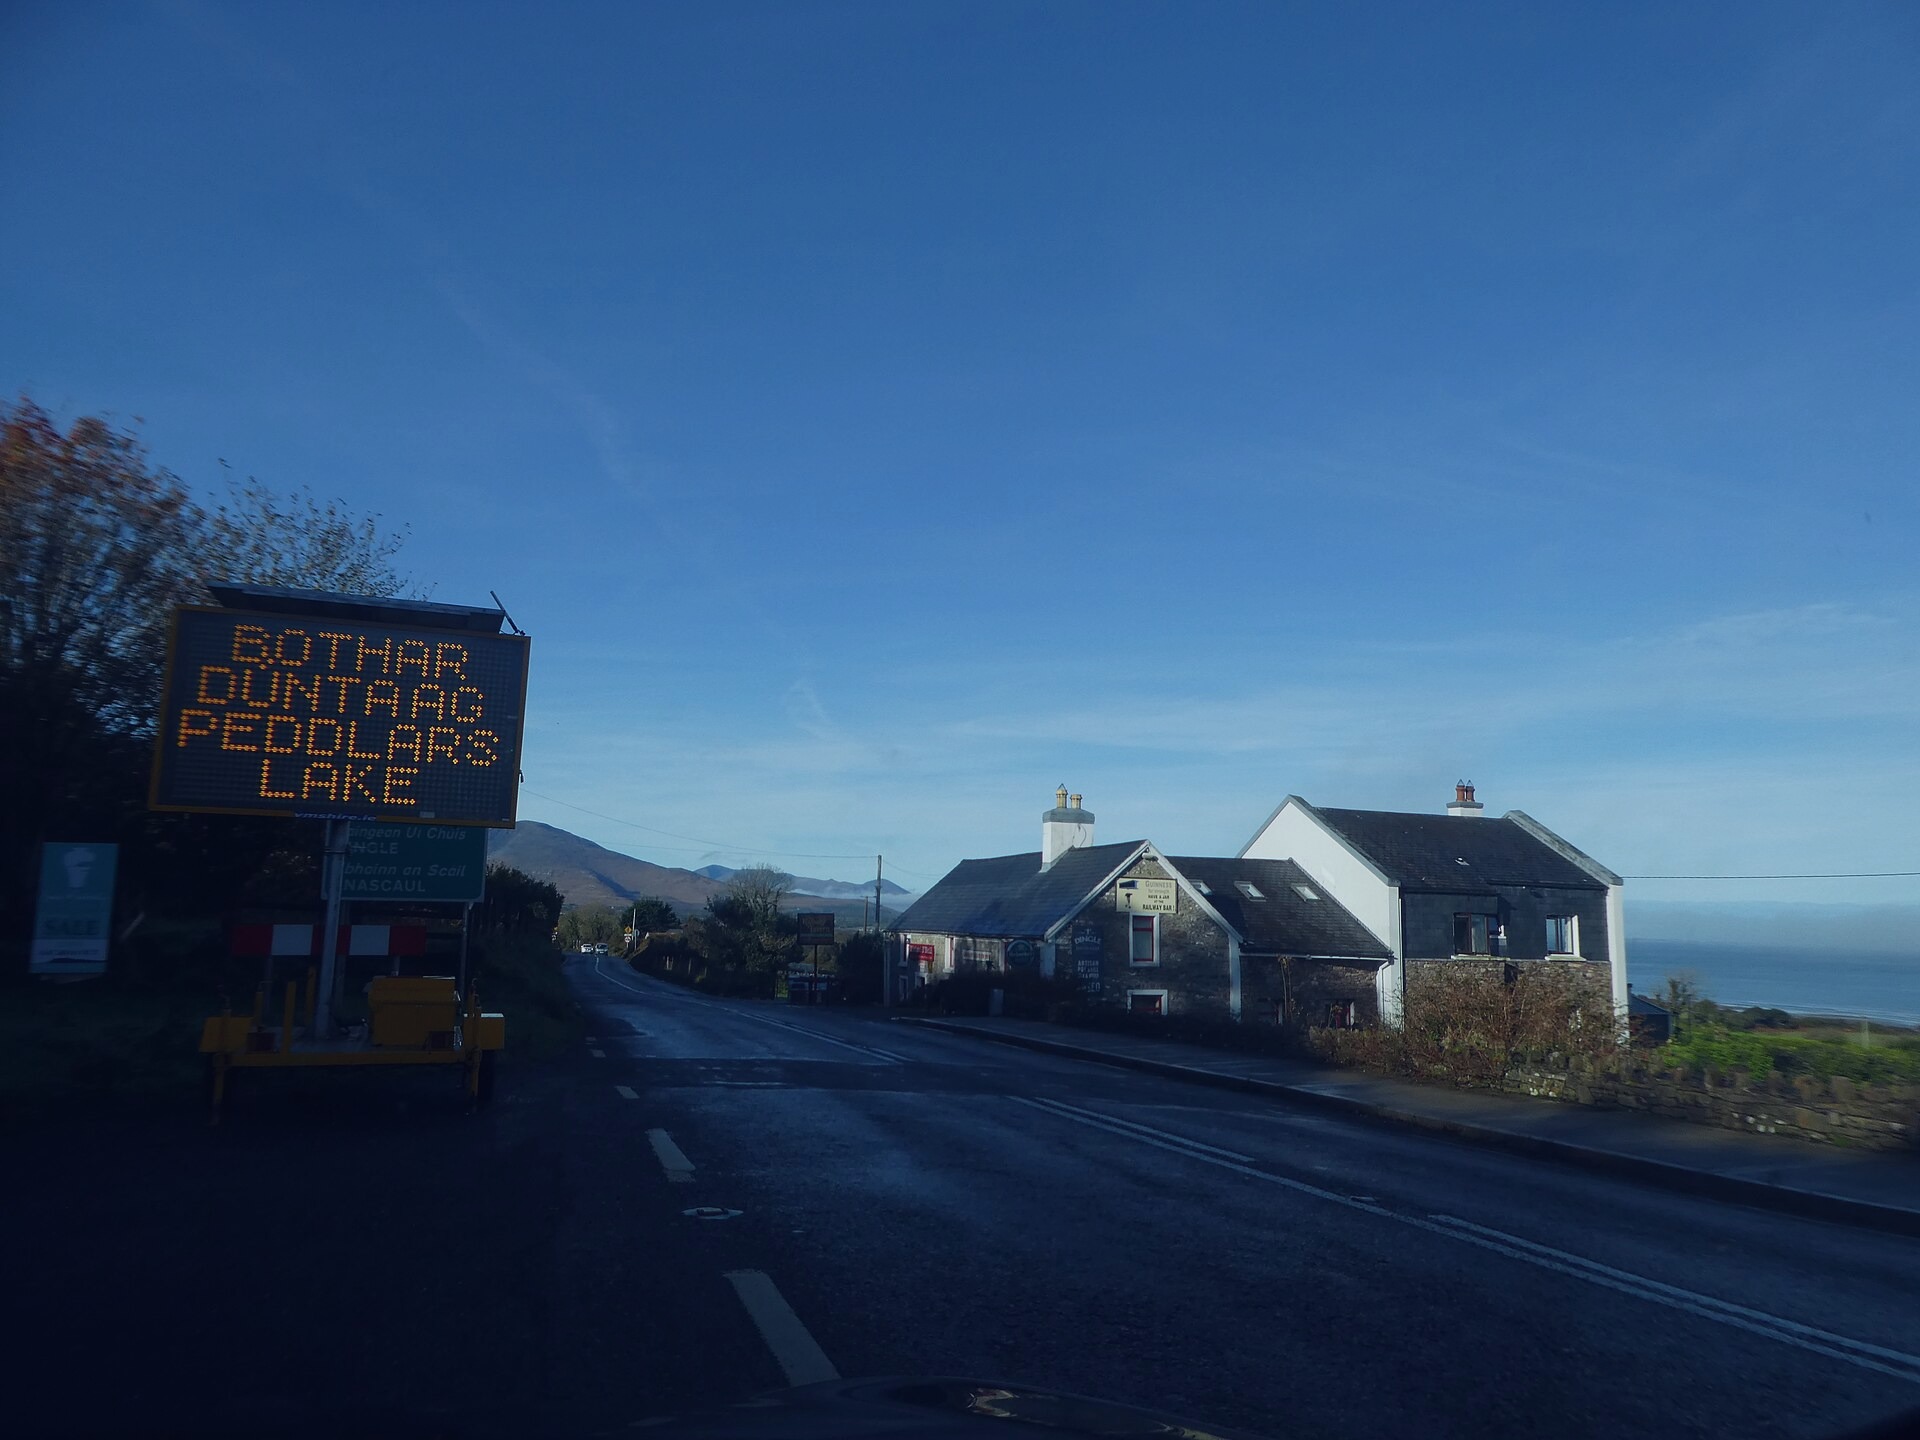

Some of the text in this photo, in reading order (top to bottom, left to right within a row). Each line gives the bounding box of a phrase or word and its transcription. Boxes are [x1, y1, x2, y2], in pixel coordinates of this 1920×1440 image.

[231, 624, 469, 682] BOTHAR
[177, 708, 499, 767] PEDDLARS
[258, 758, 420, 806] LAKE
[295, 811, 377, 822] vmshire.ie
[344, 862, 397, 875] bhainn
[403, 866, 422, 877] an
